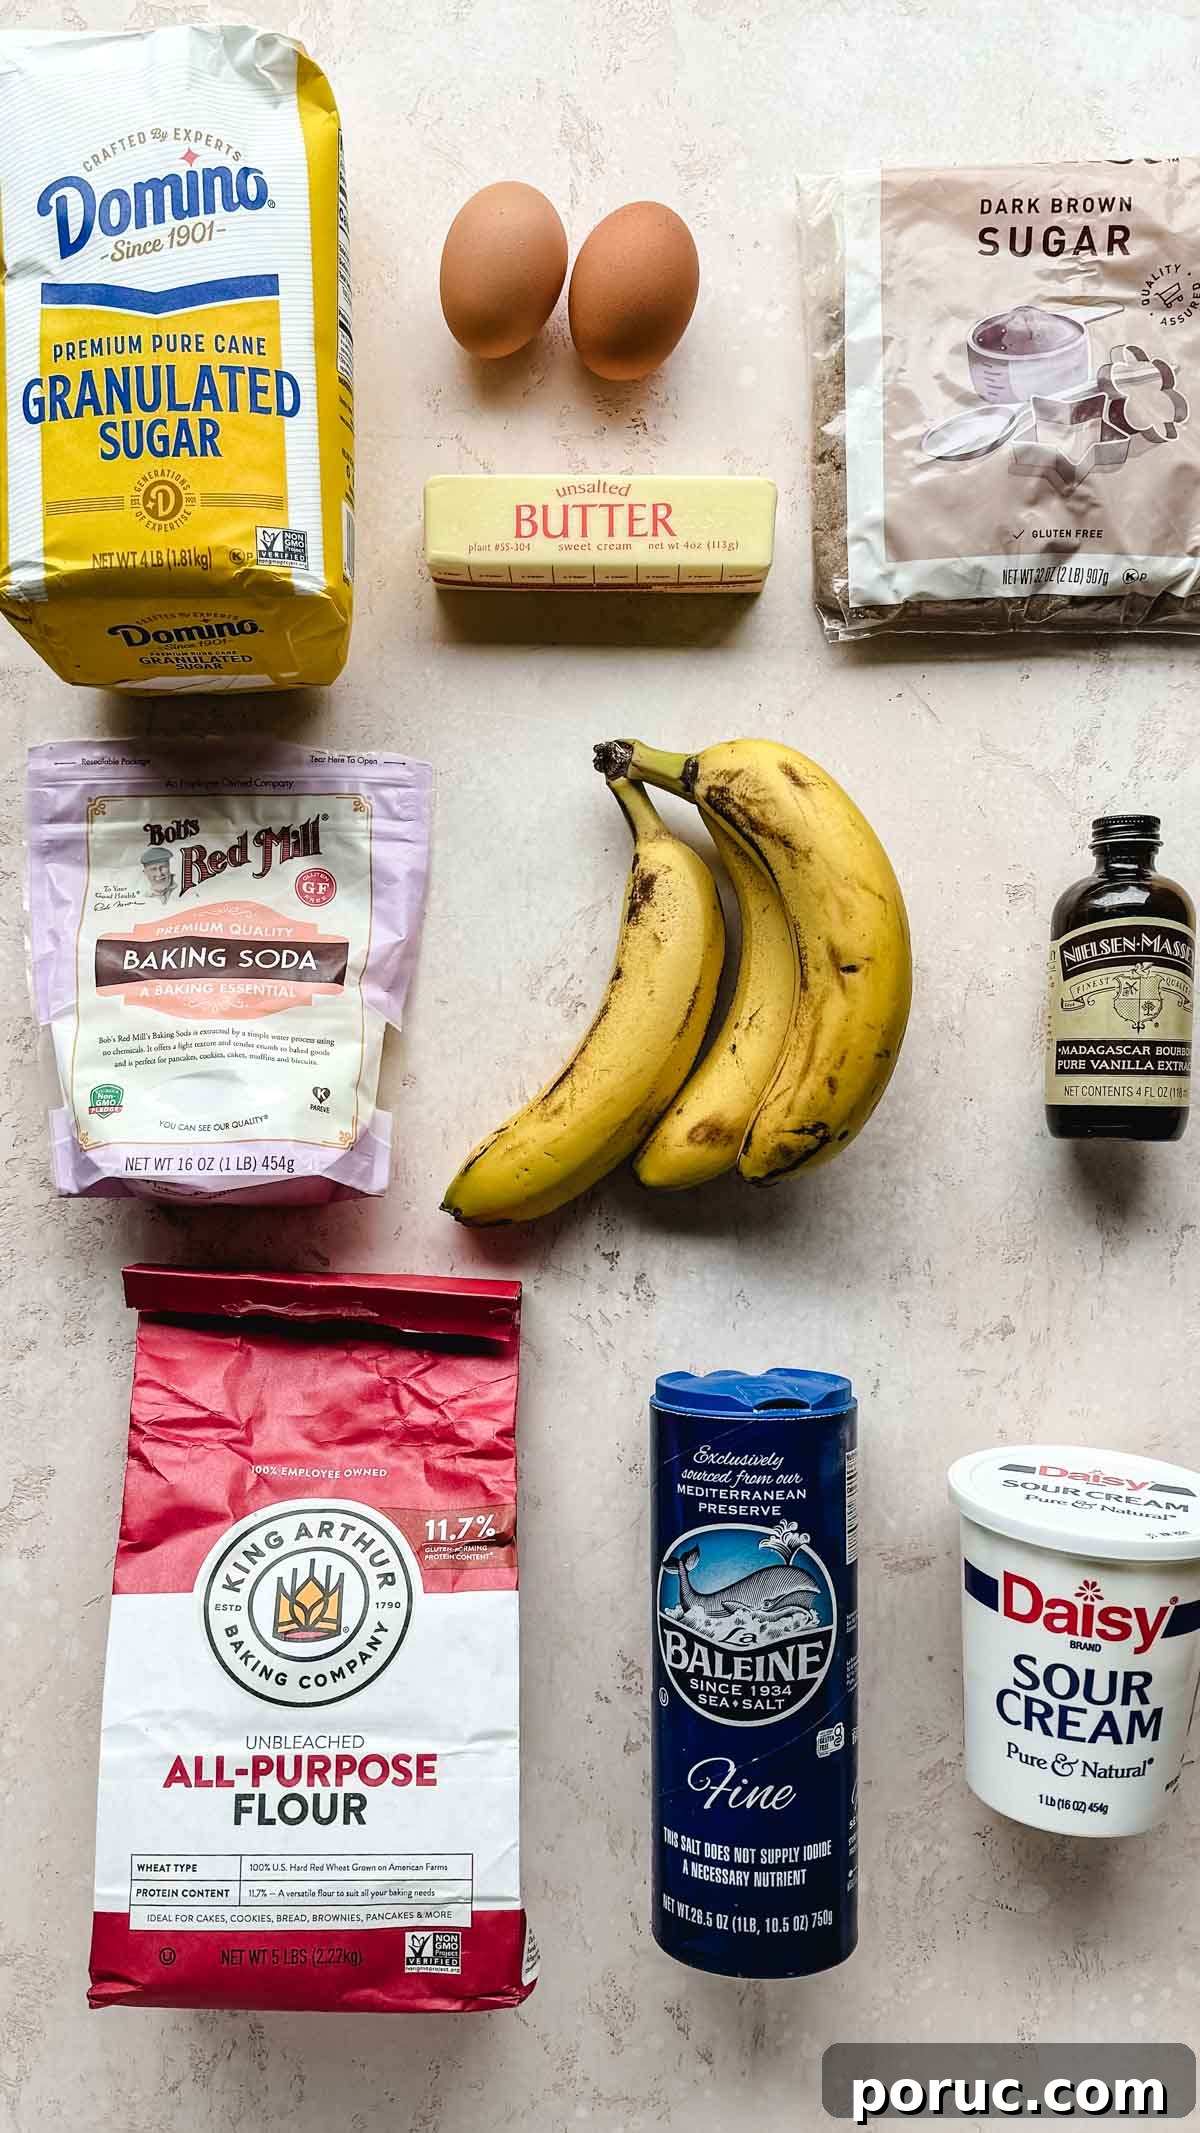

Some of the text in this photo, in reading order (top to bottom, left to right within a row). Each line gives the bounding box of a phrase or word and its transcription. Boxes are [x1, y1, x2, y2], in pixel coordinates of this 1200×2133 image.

[83, 128, 242, 172] CRAFTED By EXPERTS
[37, 166, 268, 259] Domino
[980, 197, 1132, 214] DARK BROWN
[978, 225, 1130, 257] SUGAR
[1142, 264, 1182, 306] QUALITY
[1160, 283, 1200, 326] ASSURED
[53, 334, 266, 362] PREMIUM PURE CANE
[22, 365, 300, 425] GRANULATED
[100, 418, 222, 461] SUGAR
[136, 469, 190, 492] GENERATIONS
[556, 480, 631, 498] unsalted
[146, 511, 192, 533] EXPERTISE
[514, 502, 676, 539] BUTTER
[285, 532, 304, 541] NON
[1032, 530, 1103, 538] GLUTEN FREE
[558, 540, 739, 551] sweet cream (113g)
[151, 547, 212, 571] LB (1.81kg)
[261, 552, 304, 561] VERIFIED
[1003, 566, 1109, 585] NET WT LB) 907g
[108, 619, 259, 648] Domino
[139, 655, 253, 665] GRANULATED
[251, 778, 294, 790] Company
[143, 818, 200, 846] Bob's
[179, 814, 321, 897] Red Mill
[303, 880, 329, 896] GF
[156, 924, 293, 937] PREMIUM QUALITY
[123, 947, 318, 970] BAKING SODA
[155, 983, 296, 998] BAKING ESSENTIAL
[118, 1031, 315, 1044] Red Baking process
[1061, 1046, 1150, 1055] MADAGASCAR
[134, 1056, 156, 1068] perfect
[1057, 1060, 1154, 1070] PURE VANILLA
[1064, 1086, 1167, 1097] NET CONTENTS FL OZ
[160, 1116, 263, 1132] YOU CAN SEE OUR QUALITY
[125, 1156, 294, 1173] NET WT 16 OZ LB) 454g
[694, 1445, 784, 1470] Exclusively
[251, 1465, 387, 1479] 100% EMPLOYEE OWNED
[682, 1470, 803, 1488] sourced from our
[1039, 1465, 1149, 1491] Daisy
[677, 1484, 806, 1499] MEDITERRANEAN
[1002, 1480, 1189, 1513] SOUR CREAM
[1024, 1494, 1068, 1506] Pure
[699, 1503, 781, 1515] PRESERVE
[424, 1514, 495, 1541] 11.7%
[222, 1520, 396, 1594] KING ARTHUR
[214, 1603, 242, 1612] ESTD
[375, 1601, 401, 1609] 1790
[1003, 1570, 1171, 1654] Daisy
[1070, 1640, 1101, 1652] BRAND
[225, 1622, 390, 1689] BAKING COMPANY
[664, 1629, 824, 1682] BALEINE
[690, 1679, 792, 1696] SINCE 1934
[1013, 1654, 1153, 1706] SOUR
[996, 1689, 1163, 1745] CREAM
[245, 1735, 364, 1749] UNBLEACHED
[1007, 1741, 1147, 1778] Pure & Natural
[163, 1753, 438, 1789] ALL-PURPOSE
[687, 1757, 796, 1810] Fine
[234, 1793, 367, 1826] FLOUR
[1088, 1802, 1109, 1815] 454g
[664, 1826, 831, 1864] THIS SALT DOES NOT SUPPLY IODIDE
[137, 1863, 198, 1873] WHEAT TYPE
[250, 1863, 448, 1872] 100% Hard Red Wheat Grown American Farms
[691, 1865, 806, 1887] NECESSARY NUTRIENT
[136, 1889, 230, 1898] PROTEIN CONTENT
[287, 1888, 435, 1900] versatile flour suit your baking needs
[147, 1910, 452, 1924] IDEAL FOR CAKES, COOKIES, BREAD, BROWNIES, PANCAKES MORE
[765, 1909, 832, 1933] 10.5 750g
[435, 1934, 458, 1942] NON
[435, 1941, 458, 1951] GMO
[221, 1949, 307, 1965] NET WT LBS
[408, 1958, 459, 1966] VERIFIED
